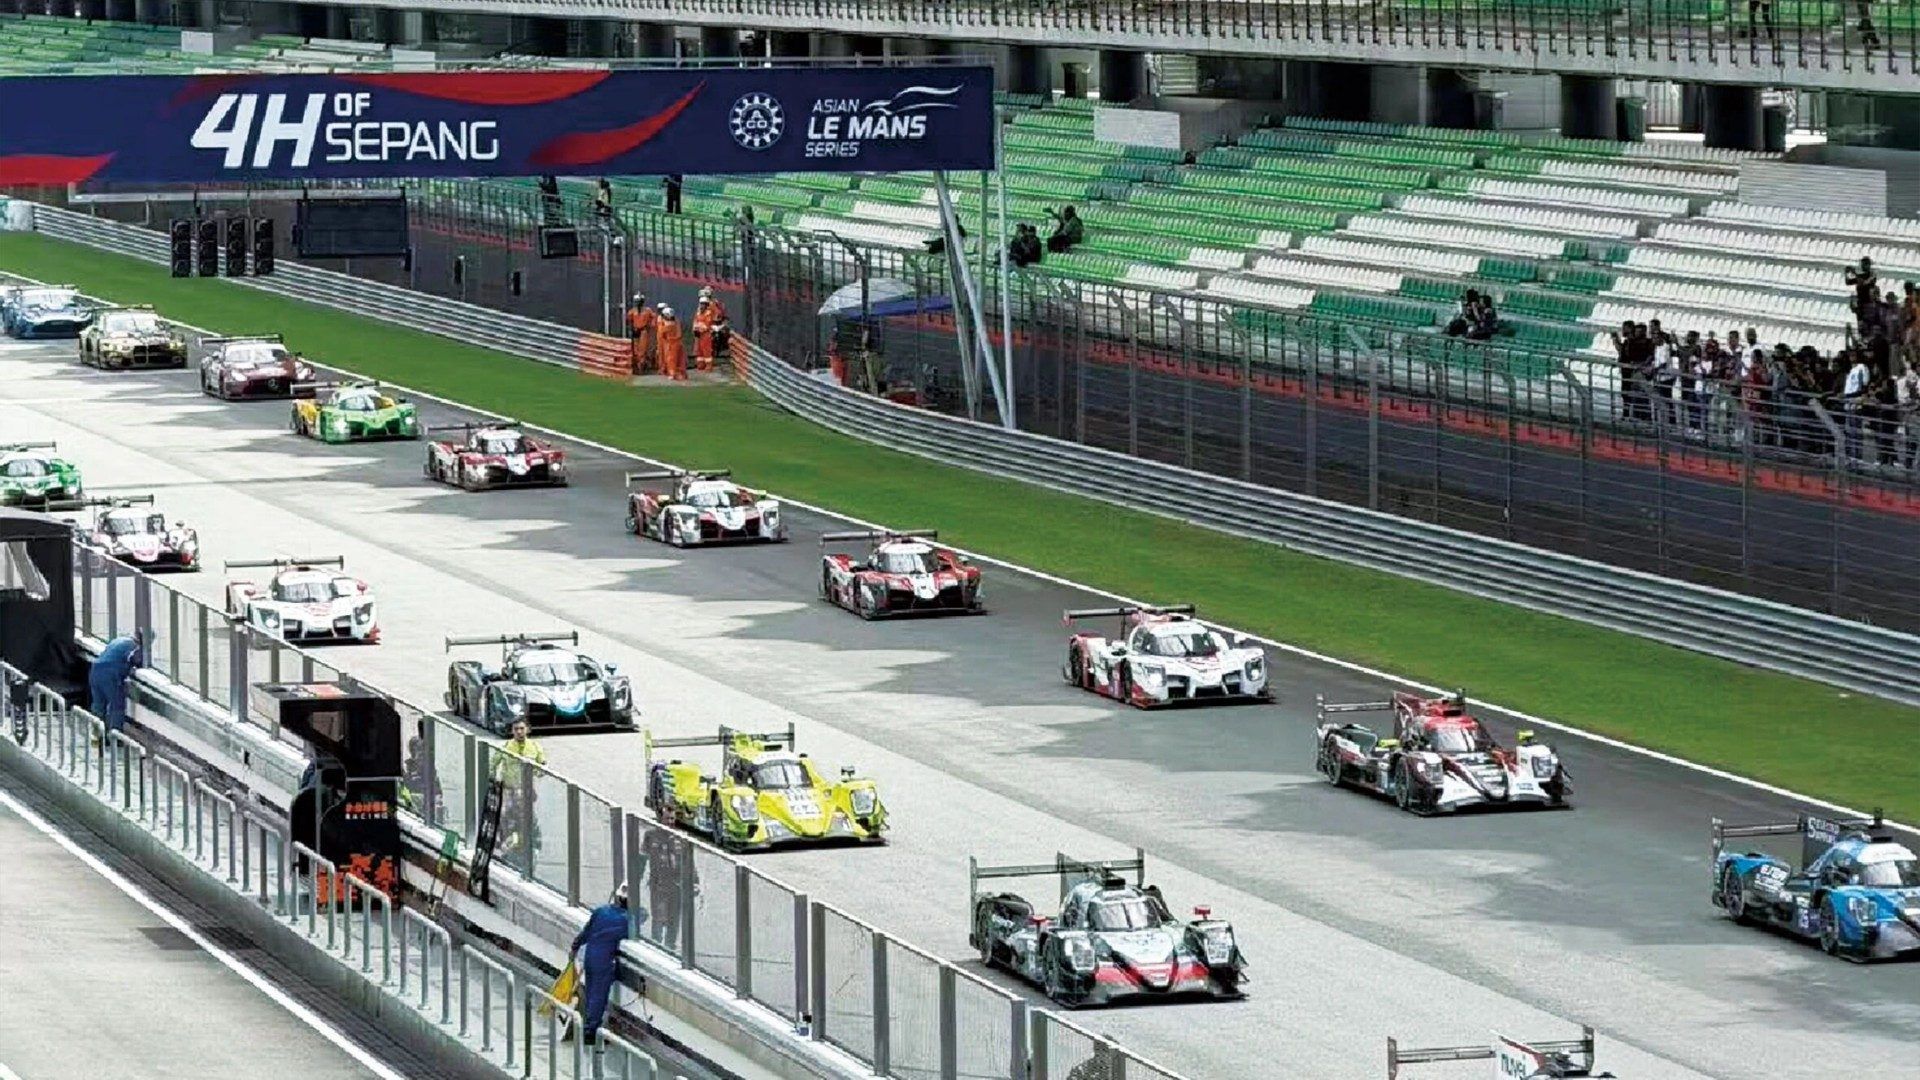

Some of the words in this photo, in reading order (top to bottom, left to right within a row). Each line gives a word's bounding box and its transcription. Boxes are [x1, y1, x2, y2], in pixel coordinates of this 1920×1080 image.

[334, 93, 370, 116] OF
[813, 99, 859, 113] ASIAN
[191, 93, 326, 168] 4H
[807, 117, 840, 139] LE
[848, 116, 927, 140] MANS
[326, 121, 498, 161] SEPANG
[805, 142, 860, 157] SERIES
